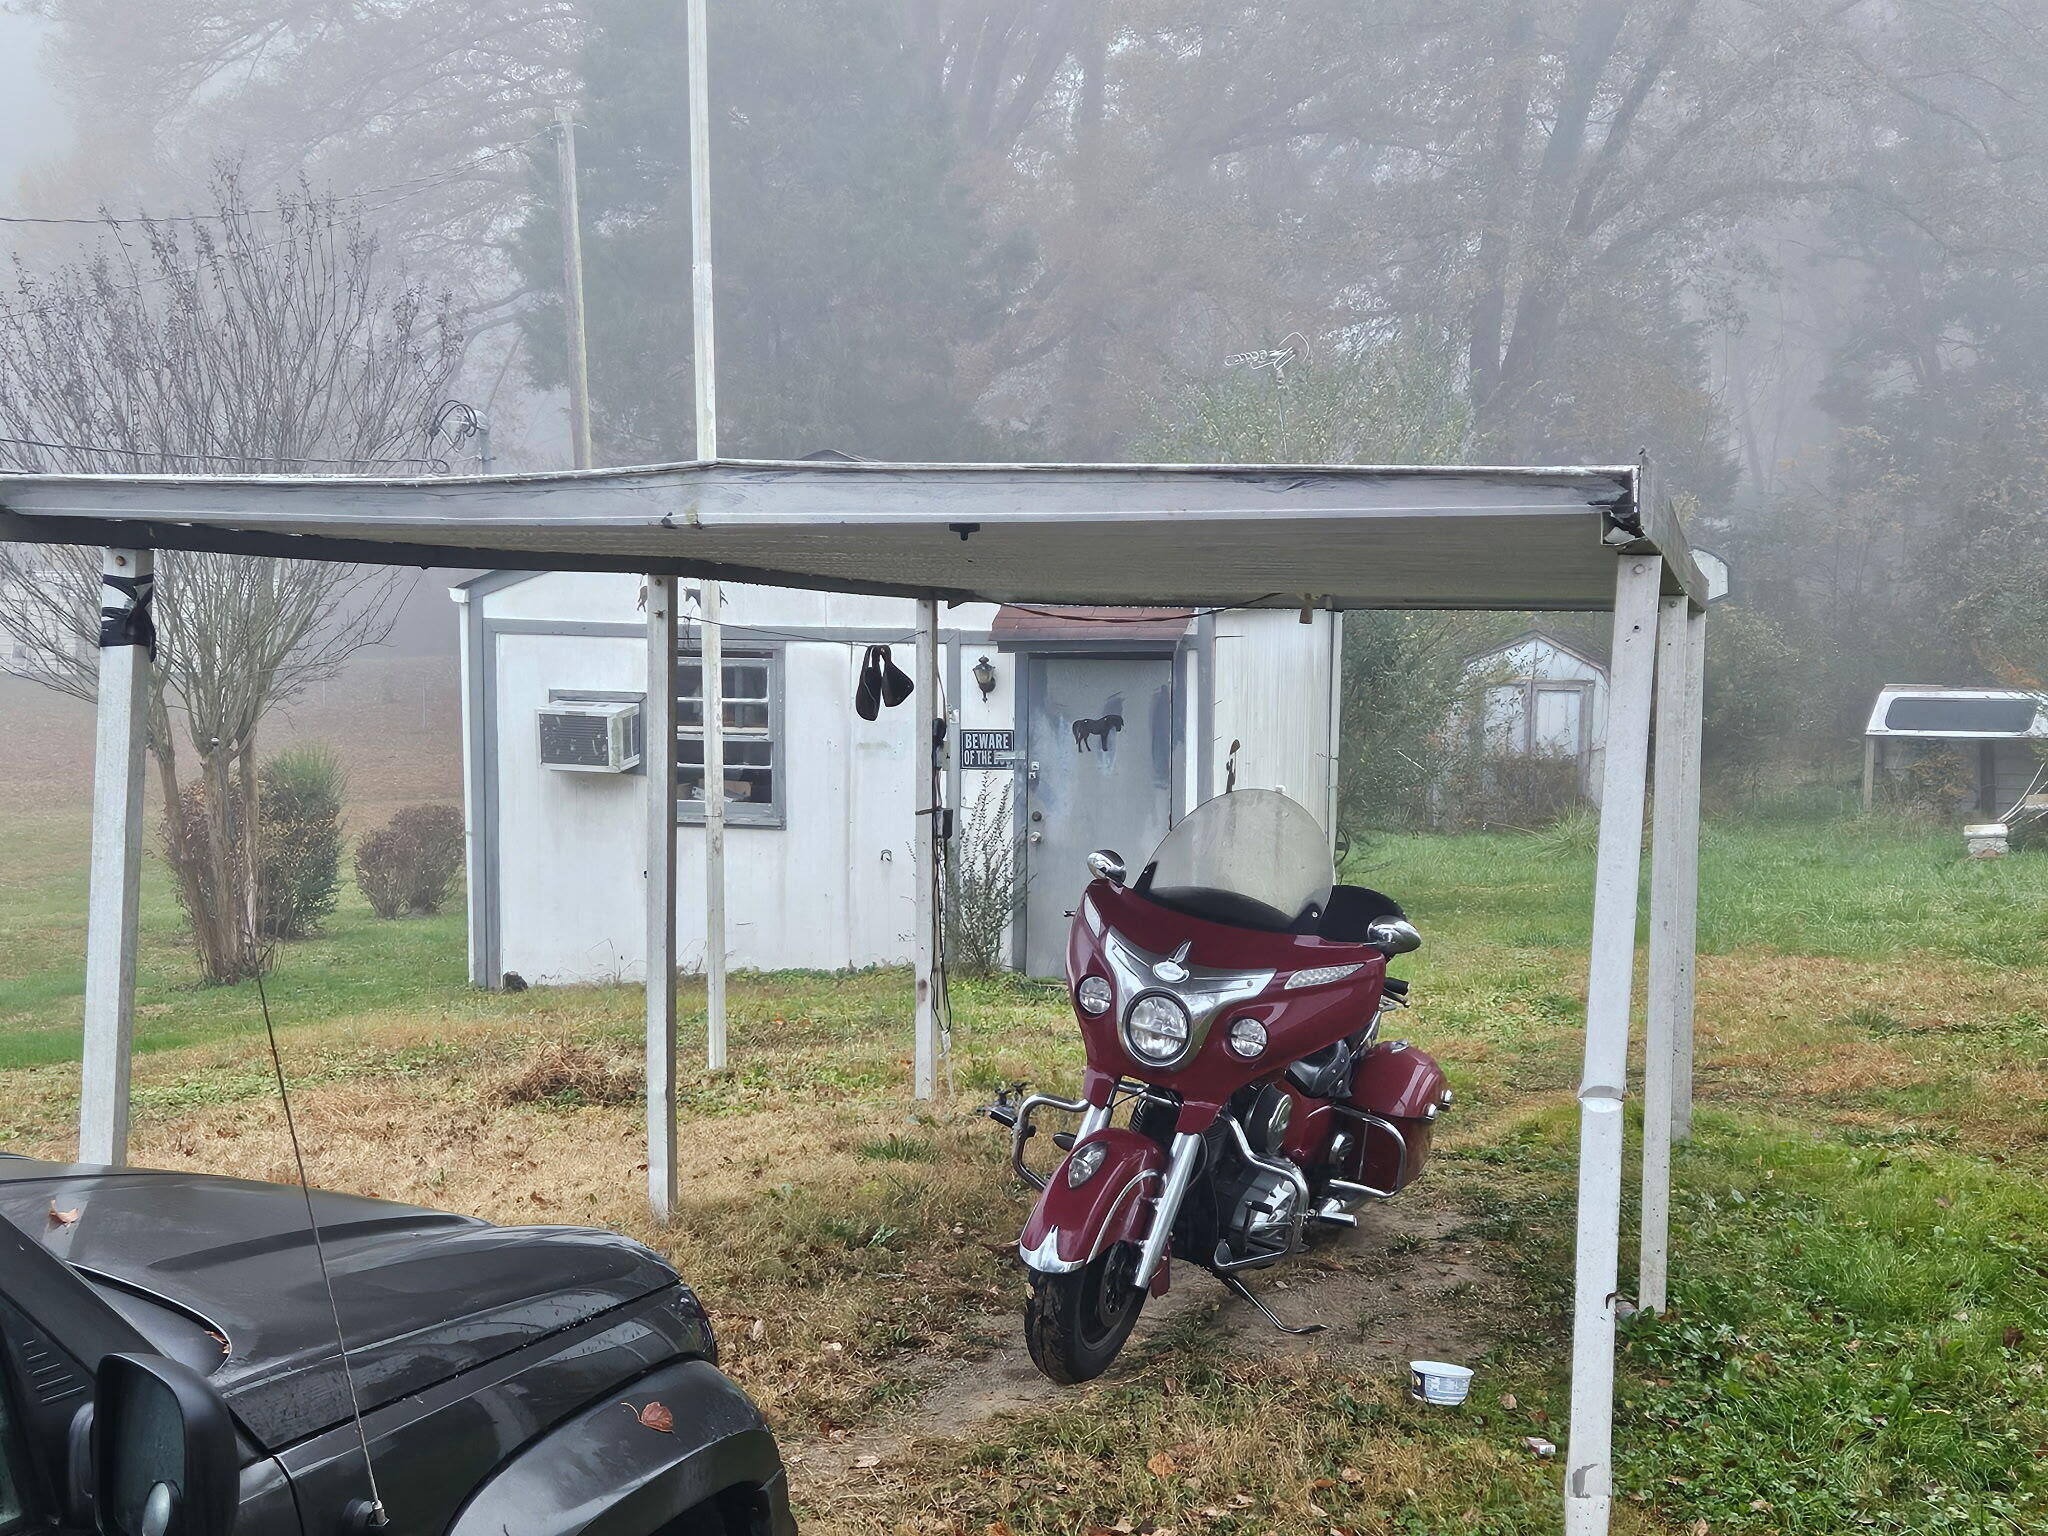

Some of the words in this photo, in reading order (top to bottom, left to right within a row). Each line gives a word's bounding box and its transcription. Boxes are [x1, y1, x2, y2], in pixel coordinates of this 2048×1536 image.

[965, 734, 1009, 749] BEWARE
[964, 750, 975, 765] OF
[976, 750, 992, 765] THE
